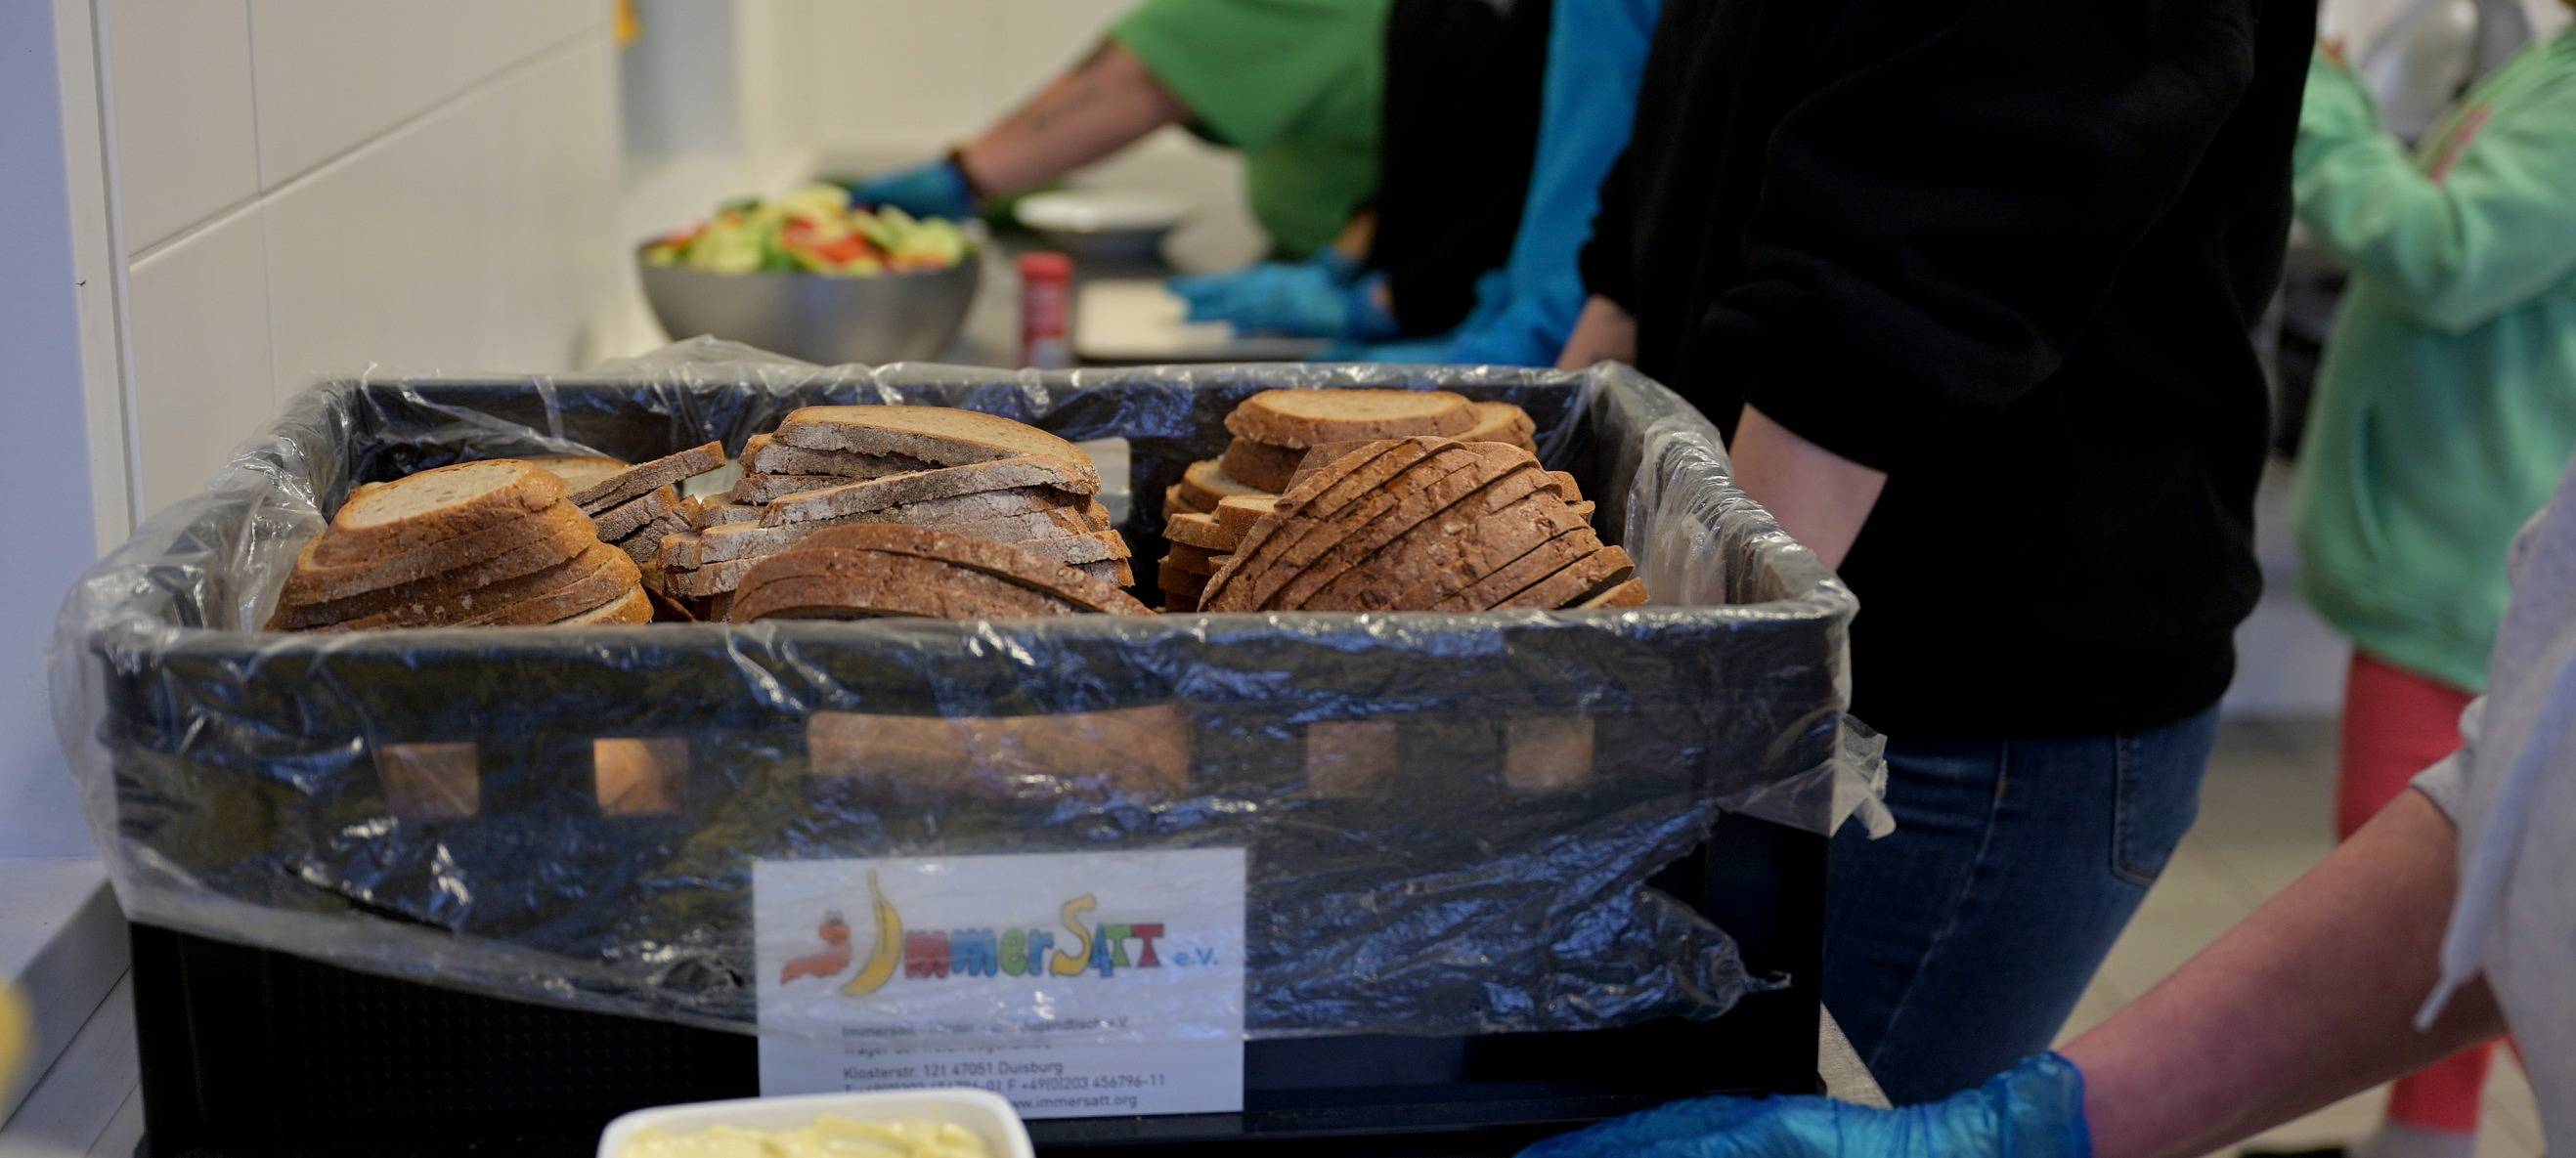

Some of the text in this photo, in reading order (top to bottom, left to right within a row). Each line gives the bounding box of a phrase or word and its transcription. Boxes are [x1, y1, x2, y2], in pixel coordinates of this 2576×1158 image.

[952, 1060, 993, 1076] 47051
[998, 1060, 1064, 1076] Duisburg
[1007, 1078, 1017, 1092] F
[1092, 1074, 1164, 1089] 456796-11
